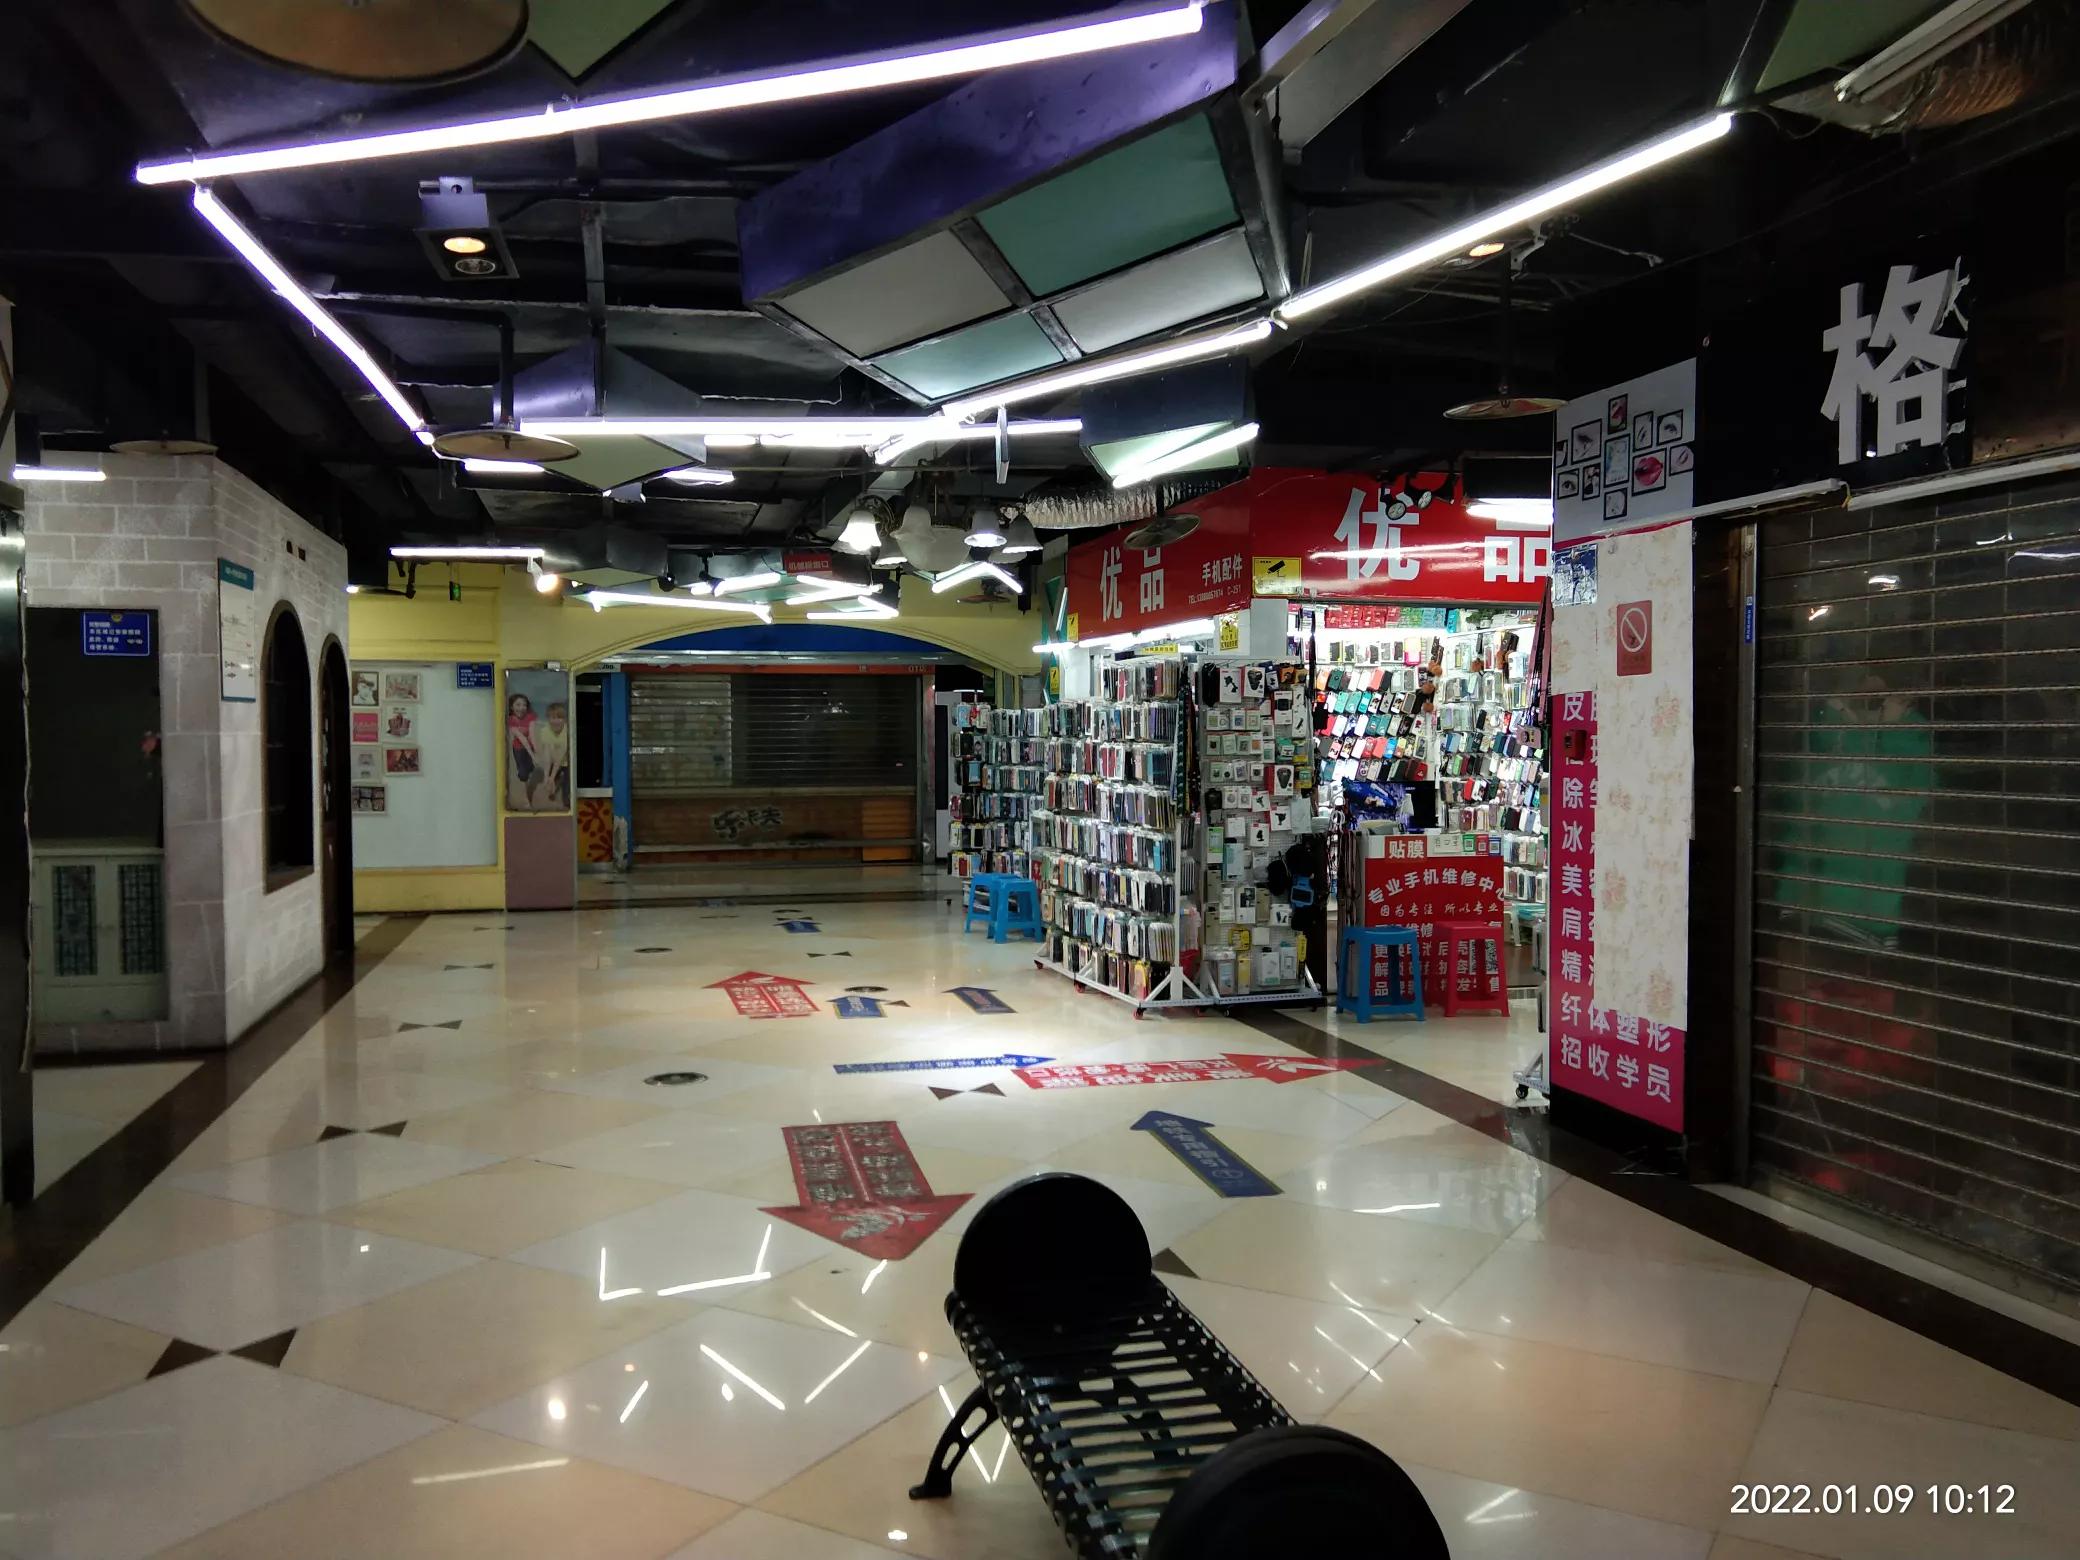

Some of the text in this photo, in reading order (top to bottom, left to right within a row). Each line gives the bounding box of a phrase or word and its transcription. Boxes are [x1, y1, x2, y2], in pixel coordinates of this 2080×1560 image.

[1821, 264, 1963, 464] 格
[1202, 553, 1243, 587] 手机配件
[1389, 840, 1424, 859] 贴膜
[1380, 902, 1499, 917] 因为专注 所以专业
[1560, 992, 1671, 1053] 纤体塑形
[1560, 1034, 1671, 1103] 招收学员
